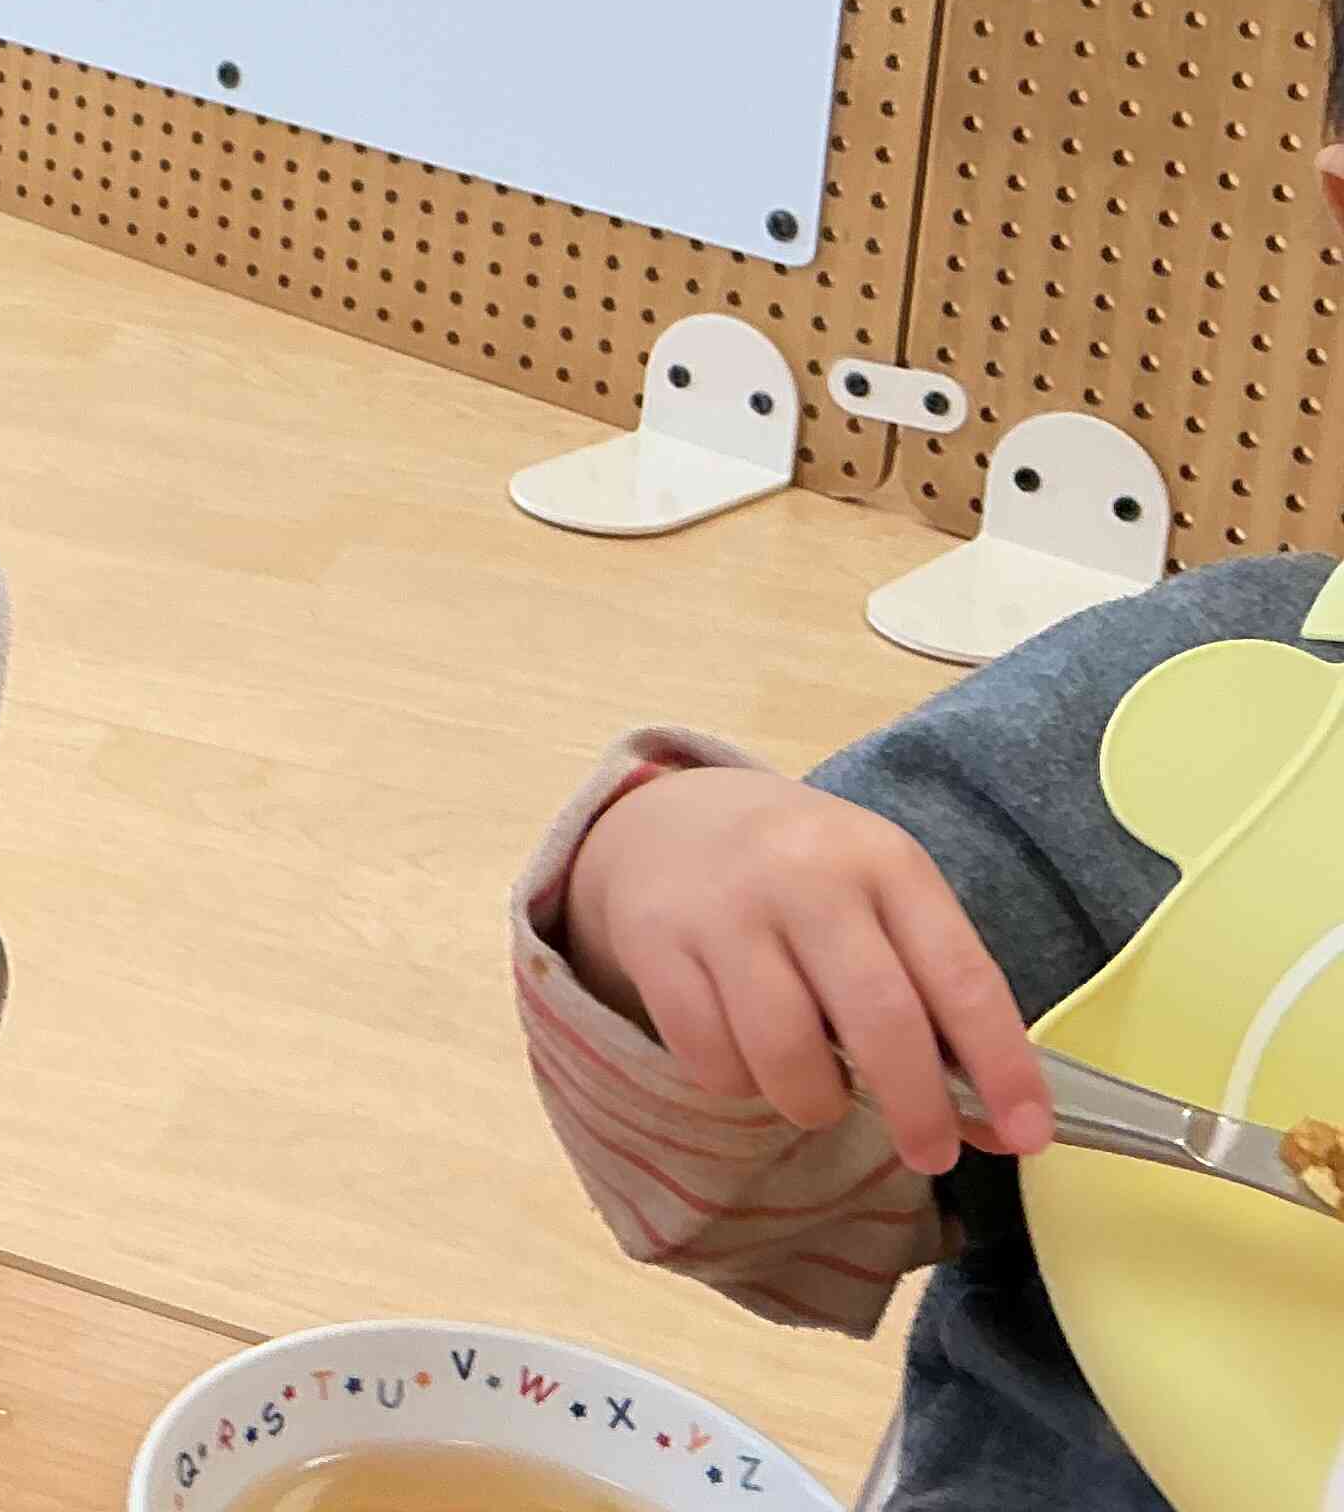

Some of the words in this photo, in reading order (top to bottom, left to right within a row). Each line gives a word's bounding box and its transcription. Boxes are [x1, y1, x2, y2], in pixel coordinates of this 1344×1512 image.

[177, 1452, 200, 1488] Q
[216, 1417, 235, 1451] R
[262, 1401, 285, 1437] S
[310, 1369, 335, 1400] T
[377, 1378, 405, 1408] U
[451, 1348, 477, 1381] V
[519, 1365, 561, 1405] W
[606, 1396, 637, 1431] X
[685, 1422, 713, 1454] Y
[737, 1455, 764, 1492] Z
